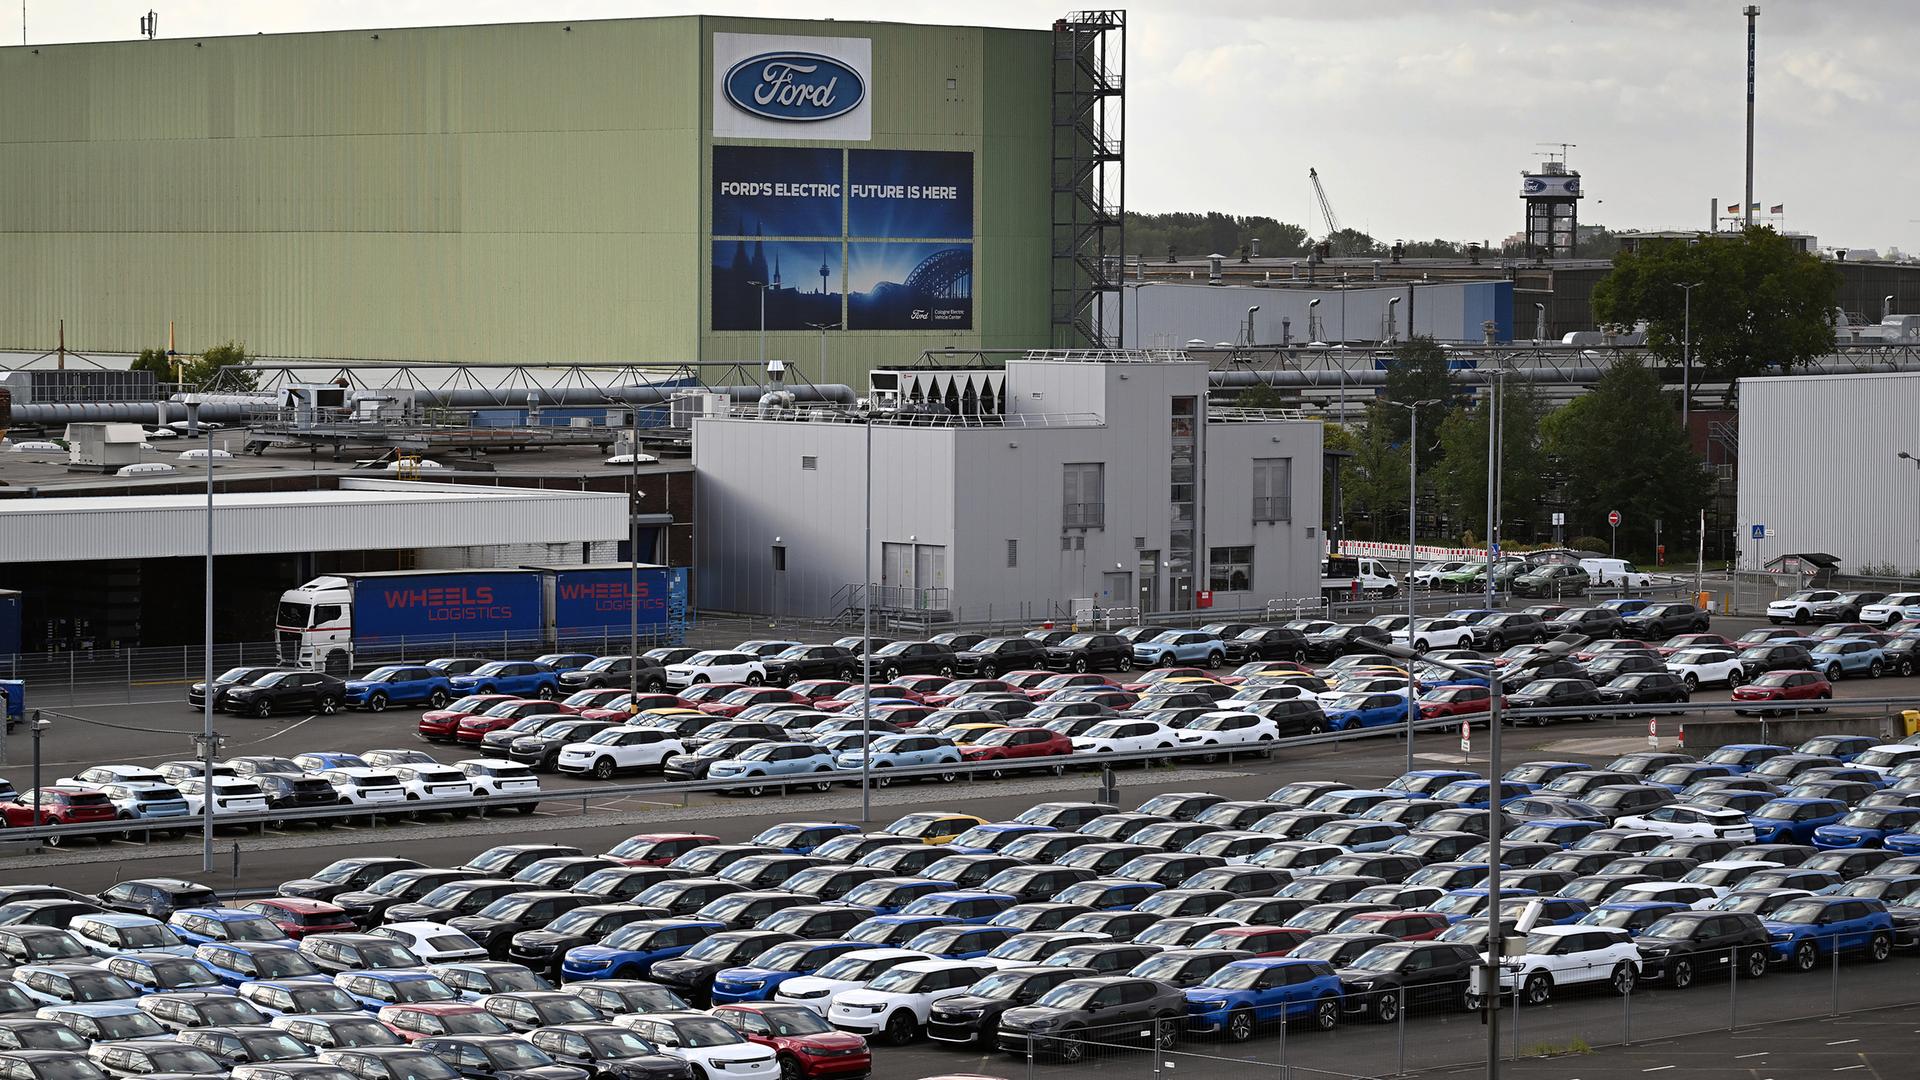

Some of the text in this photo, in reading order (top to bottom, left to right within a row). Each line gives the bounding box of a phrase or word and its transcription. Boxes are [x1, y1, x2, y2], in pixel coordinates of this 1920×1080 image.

[754, 62, 838, 107] Ford
[721, 182, 957, 199] FORD'S ELECTRIC FUTURE IS HERE
[911, 309, 929, 319] Ford
[384, 586, 494, 609] WHEELS
[560, 582, 649, 600] WHEELS
[595, 598, 665, 611] LOGISTICS
[428, 606, 513, 621] LOGISTICS
